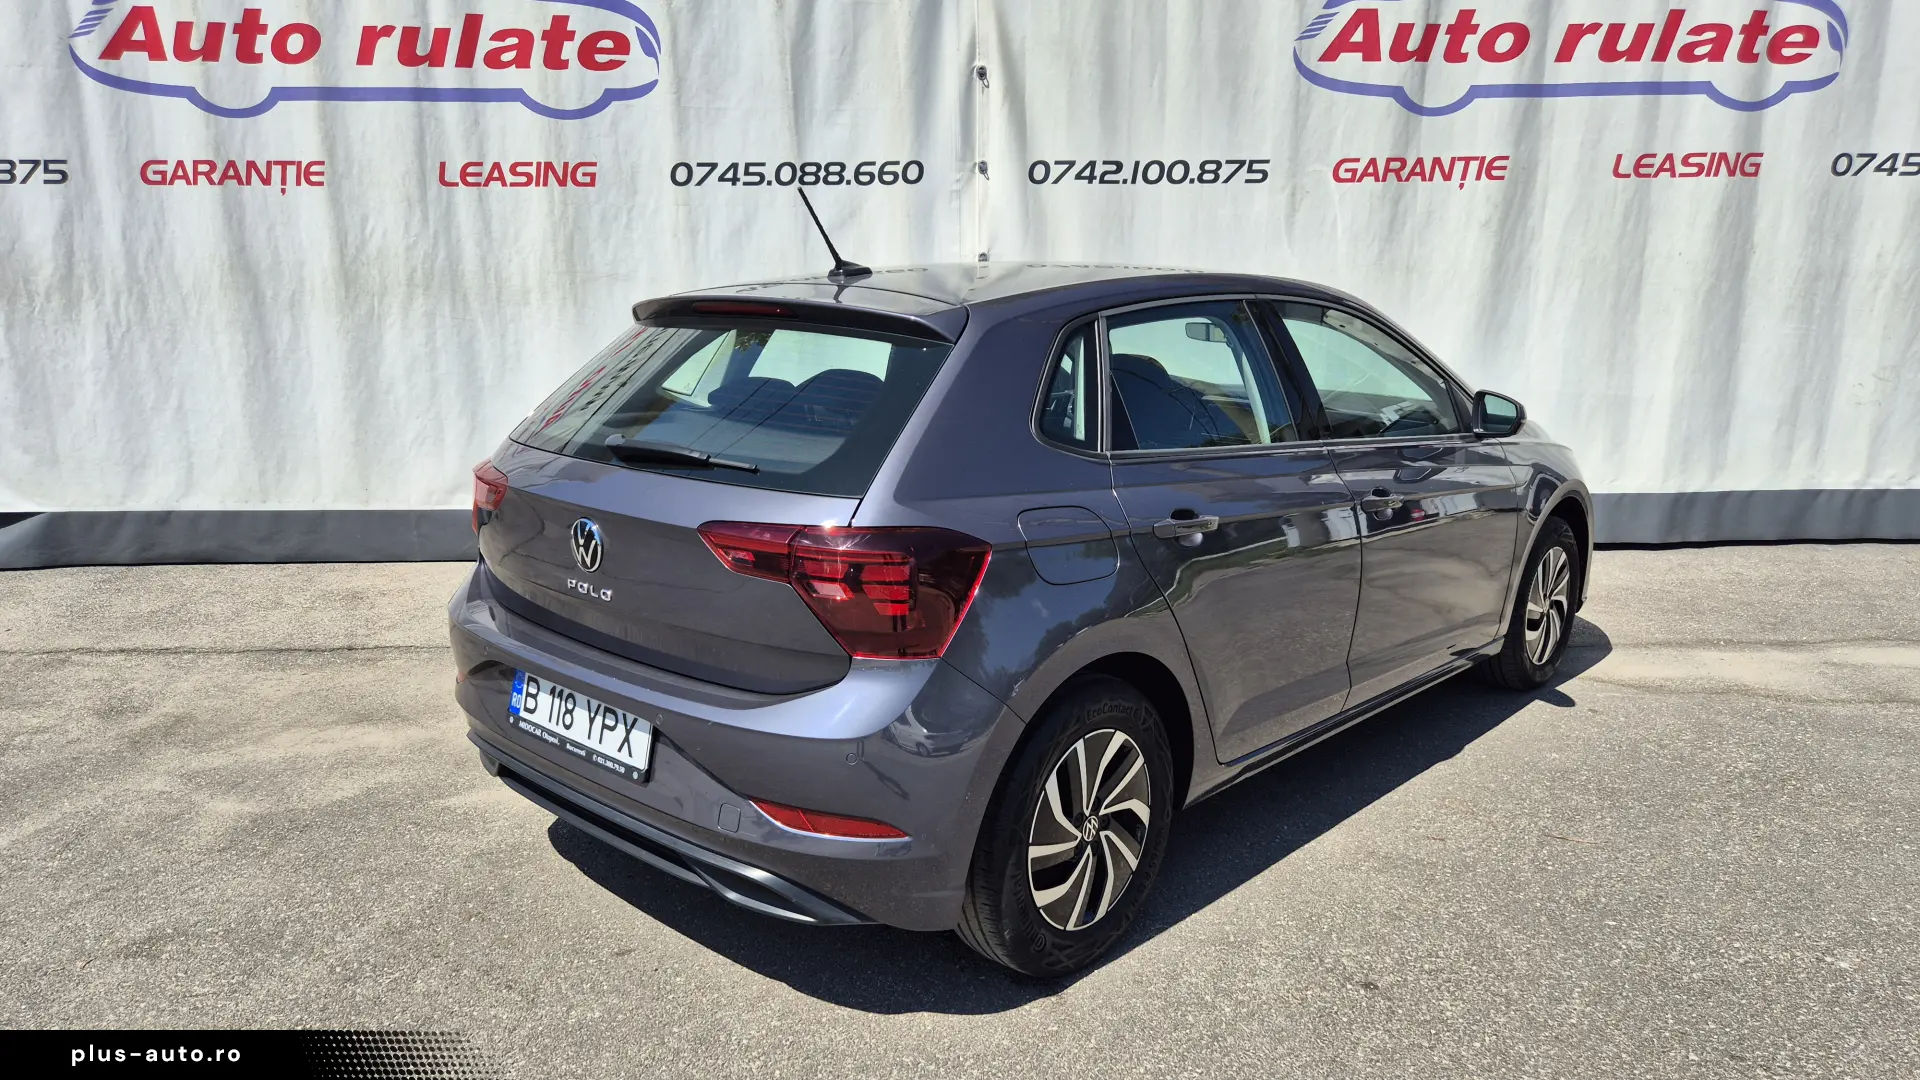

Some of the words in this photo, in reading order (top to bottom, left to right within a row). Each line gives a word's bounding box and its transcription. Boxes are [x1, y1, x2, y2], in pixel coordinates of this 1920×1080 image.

[100, 6, 321, 64] Auto
[357, 14, 631, 71] rulate
[1319, 9, 1530, 64] Auto
[1555, 10, 1820, 64] rulate
[141, 160, 324, 194] GARANȚIE
[439, 162, 597, 187] LEASING
[671, 160, 924, 186] 0745.088.660
[1029, 160, 1270, 184] 0742.100.875
[1333, 156, 1509, 189] GARANȚIE
[1613, 153, 1763, 178] LEASING
[567, 578, 613, 602] POLO
[511, 692, 521, 709] RO
[1086, 701, 1133, 721] EcoContact
[523, 675, 541, 714] B
[548, 685, 577, 731] 118
[587, 699, 639, 759] YPX
